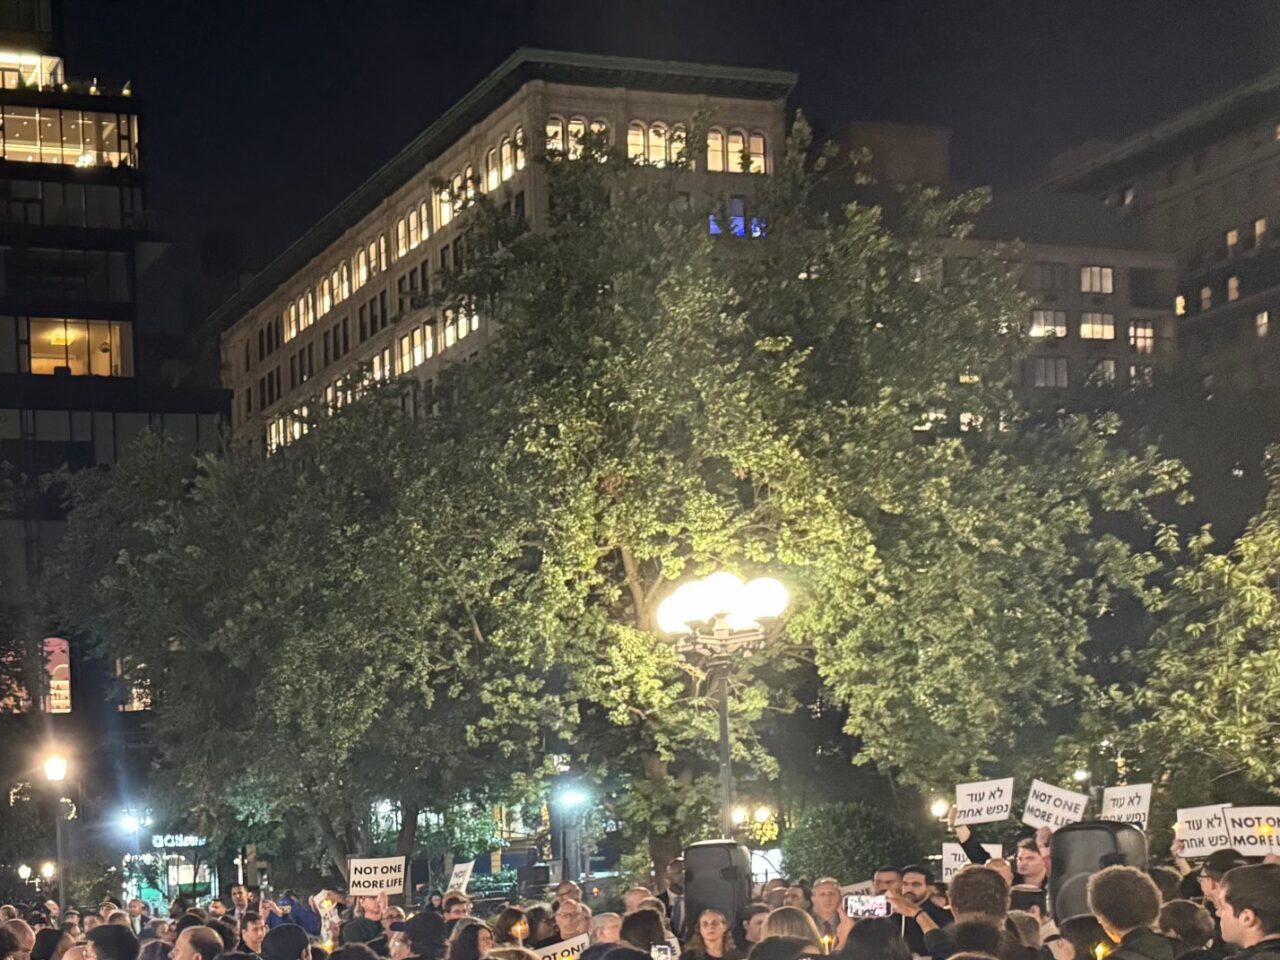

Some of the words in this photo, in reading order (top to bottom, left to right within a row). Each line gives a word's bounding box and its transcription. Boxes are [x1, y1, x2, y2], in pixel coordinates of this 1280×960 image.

[966, 792, 985, 802] עוד
[989, 787, 1003, 799] לא
[1032, 789, 1053, 805] NOT
[1053, 797, 1081, 814] ONE
[1110, 797, 1125, 808] עוד
[1128, 792, 1141, 806] לא
[957, 807, 983, 819] אחת
[986, 804, 1009, 815] נפש
[1027, 804, 1053, 822] MORE
[1053, 815, 1072, 826] LIF
[1185, 818, 1202, 830] עוד
[1207, 813, 1222, 828] לא
[1231, 817, 1262, 828] NOT
[1208, 835, 1228, 846] פש
[1233, 835, 1274, 846] MORE
[354, 866, 378, 875] NOT
[380, 864, 402, 874] ONE
[351, 880, 384, 888] MORE
[386, 878, 403, 887] LIFE
